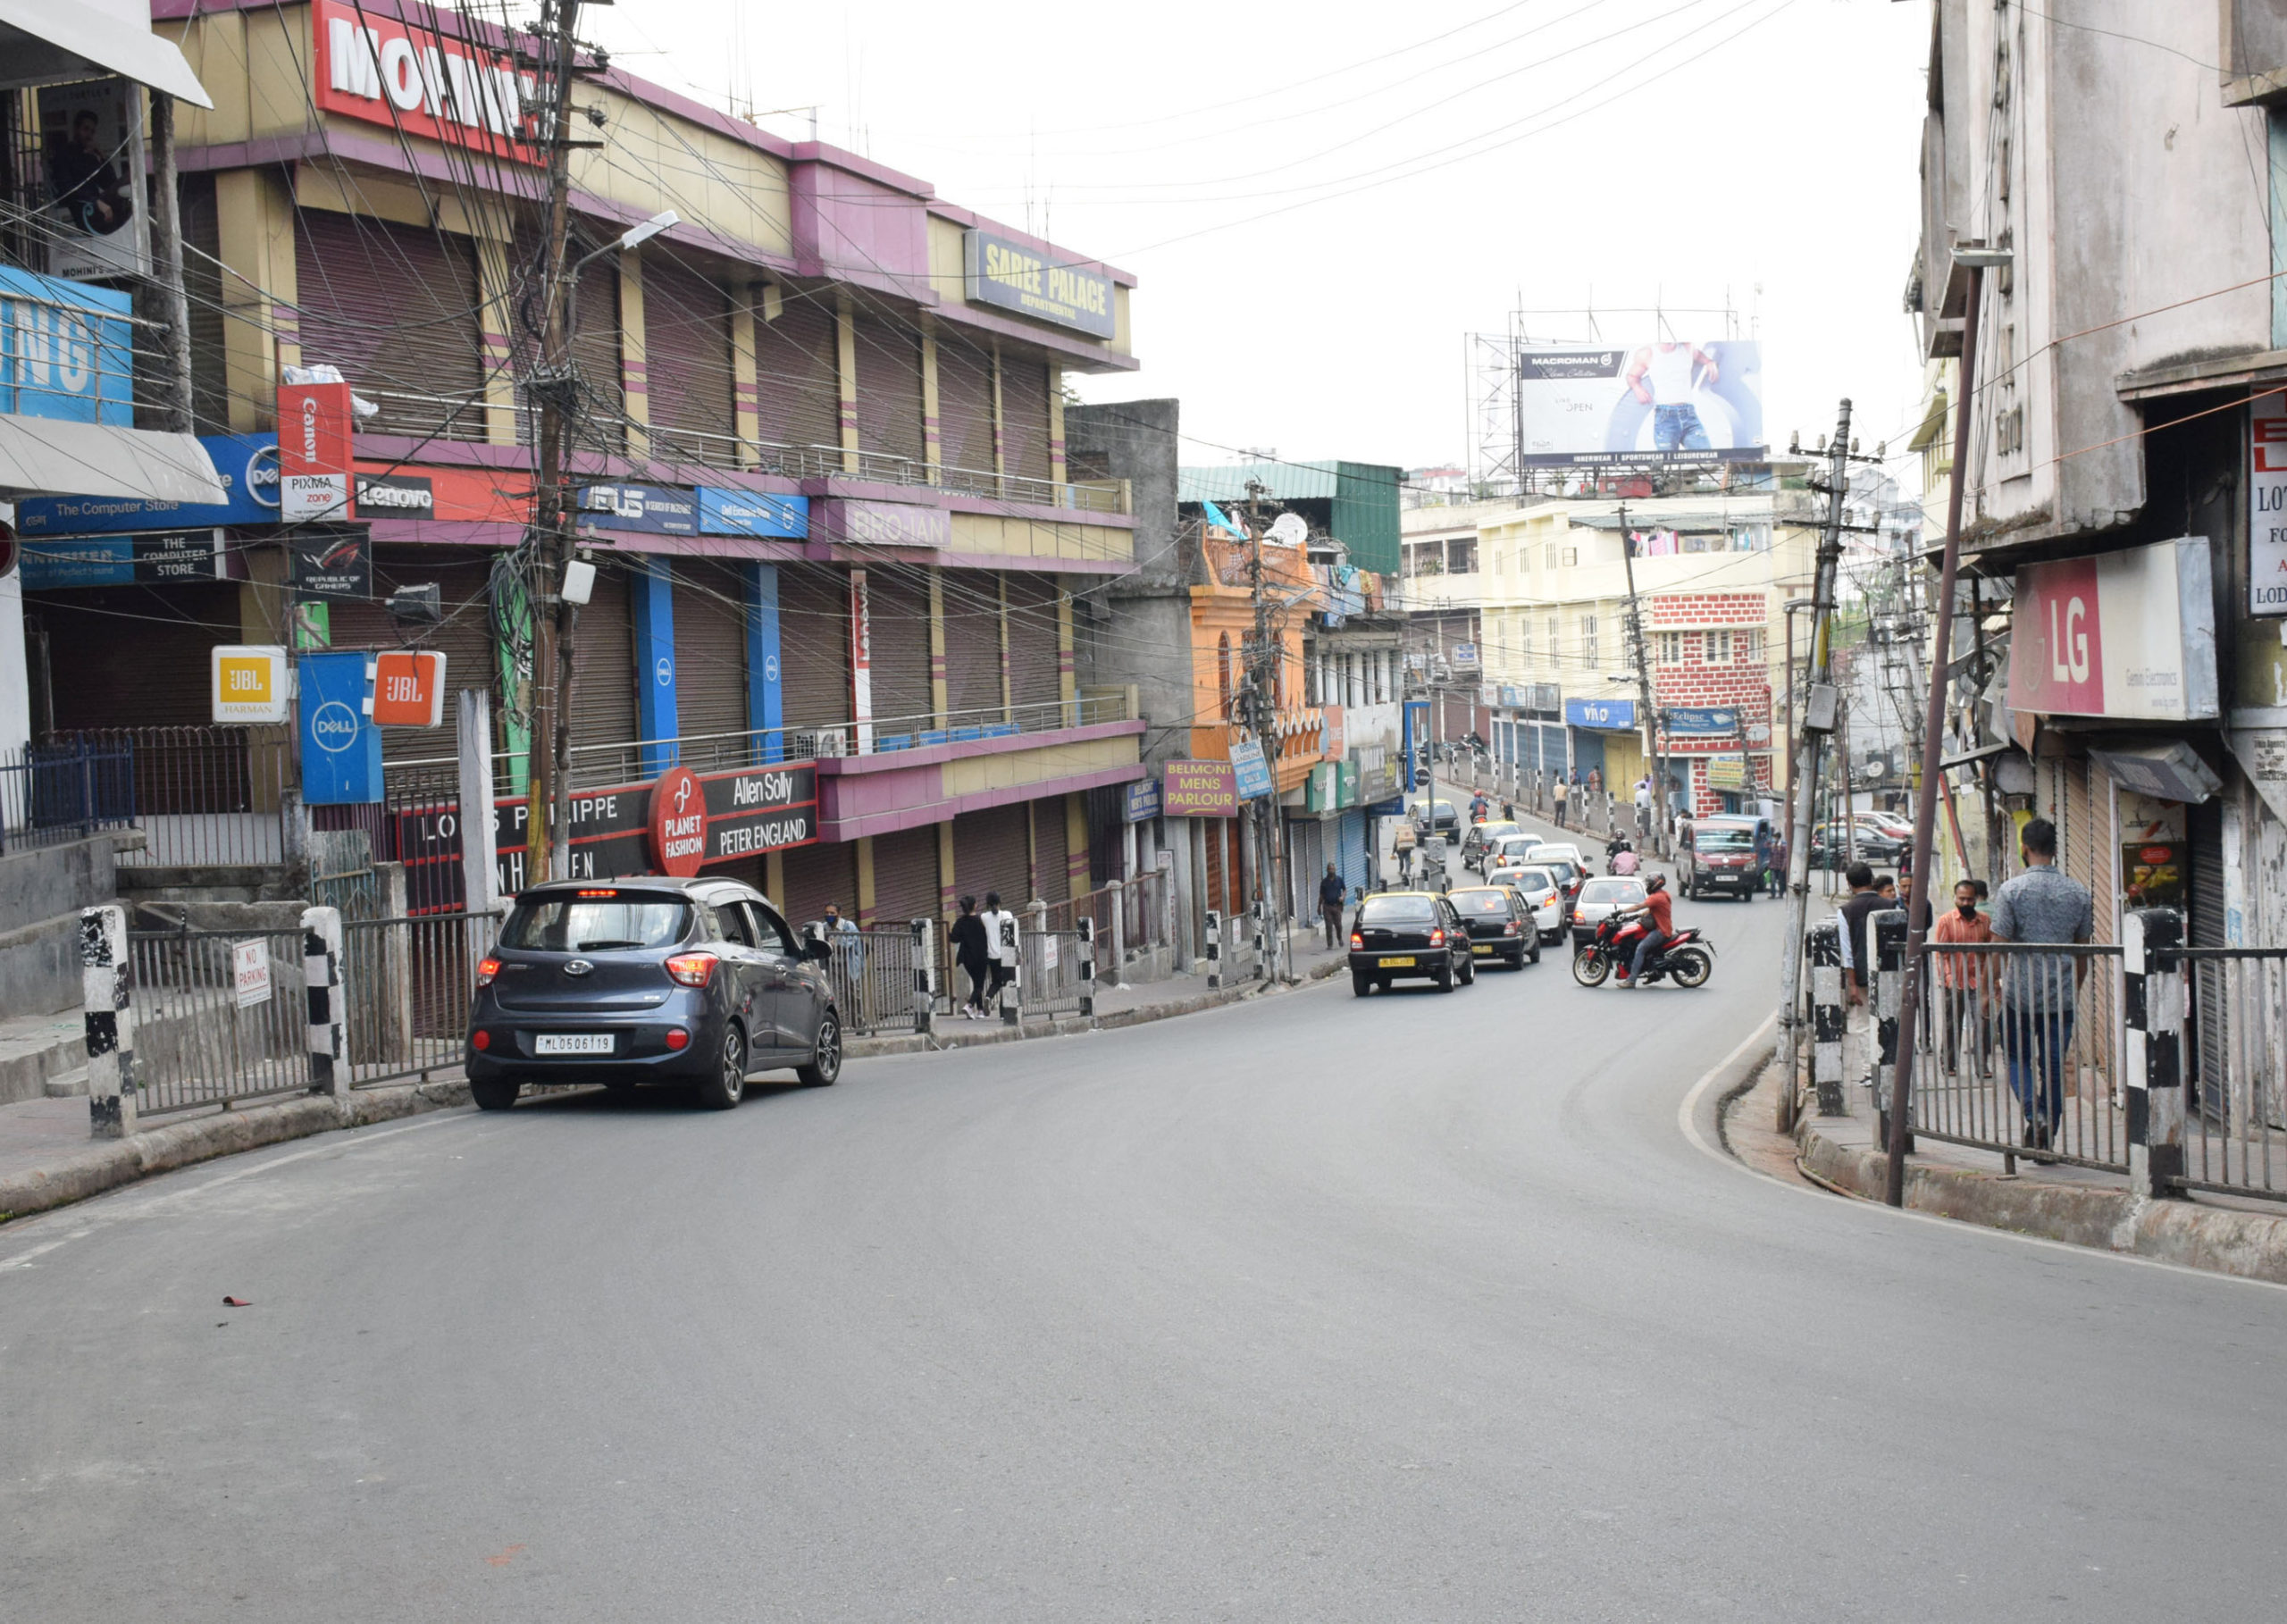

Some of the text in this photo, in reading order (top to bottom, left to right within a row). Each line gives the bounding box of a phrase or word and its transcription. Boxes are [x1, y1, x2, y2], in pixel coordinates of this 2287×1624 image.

[62, 265, 105, 278] MOHINI'S
[985, 244, 1106, 316] SAREE PALACE
[1020, 293, 1076, 320] DEPARTMENTAL
[1531, 356, 1598, 365] MACROMAN
[303, 397, 316, 463] Canon
[1573, 451, 1718, 463] INNERWEAR SPORTSWEAR LEISUREWEAR
[292, 477, 332, 490] PIXMA
[307, 493, 331, 503] zone
[358, 481, 433, 507] Lenovo
[2258, 485, 2287, 512] LO
[56, 499, 179, 517] The Computer Store
[163, 538, 186, 549] THE
[143, 549, 207, 562] COMPUTER
[157, 564, 194, 576] STORE
[2051, 596, 2090, 684] LG
[230, 670, 263, 691] JBL
[387, 676, 423, 702] JBL
[225, 706, 272, 714] HARMAN
[318, 721, 353, 733] DELL
[1168, 764, 1232, 774] BELMONT
[733, 772, 792, 806] Allen Solly
[1179, 776, 1220, 790] MEN'S
[1168, 793, 1233, 805] PARLOUR
[515, 795, 617, 830] PIIPPE
[665, 815, 702, 838] PLANET
[720, 818, 806, 856] PETER ENGLAND
[666, 837, 702, 858] FASHION
[246, 949, 257, 966] NO
[239, 967, 266, 988] PARKING
